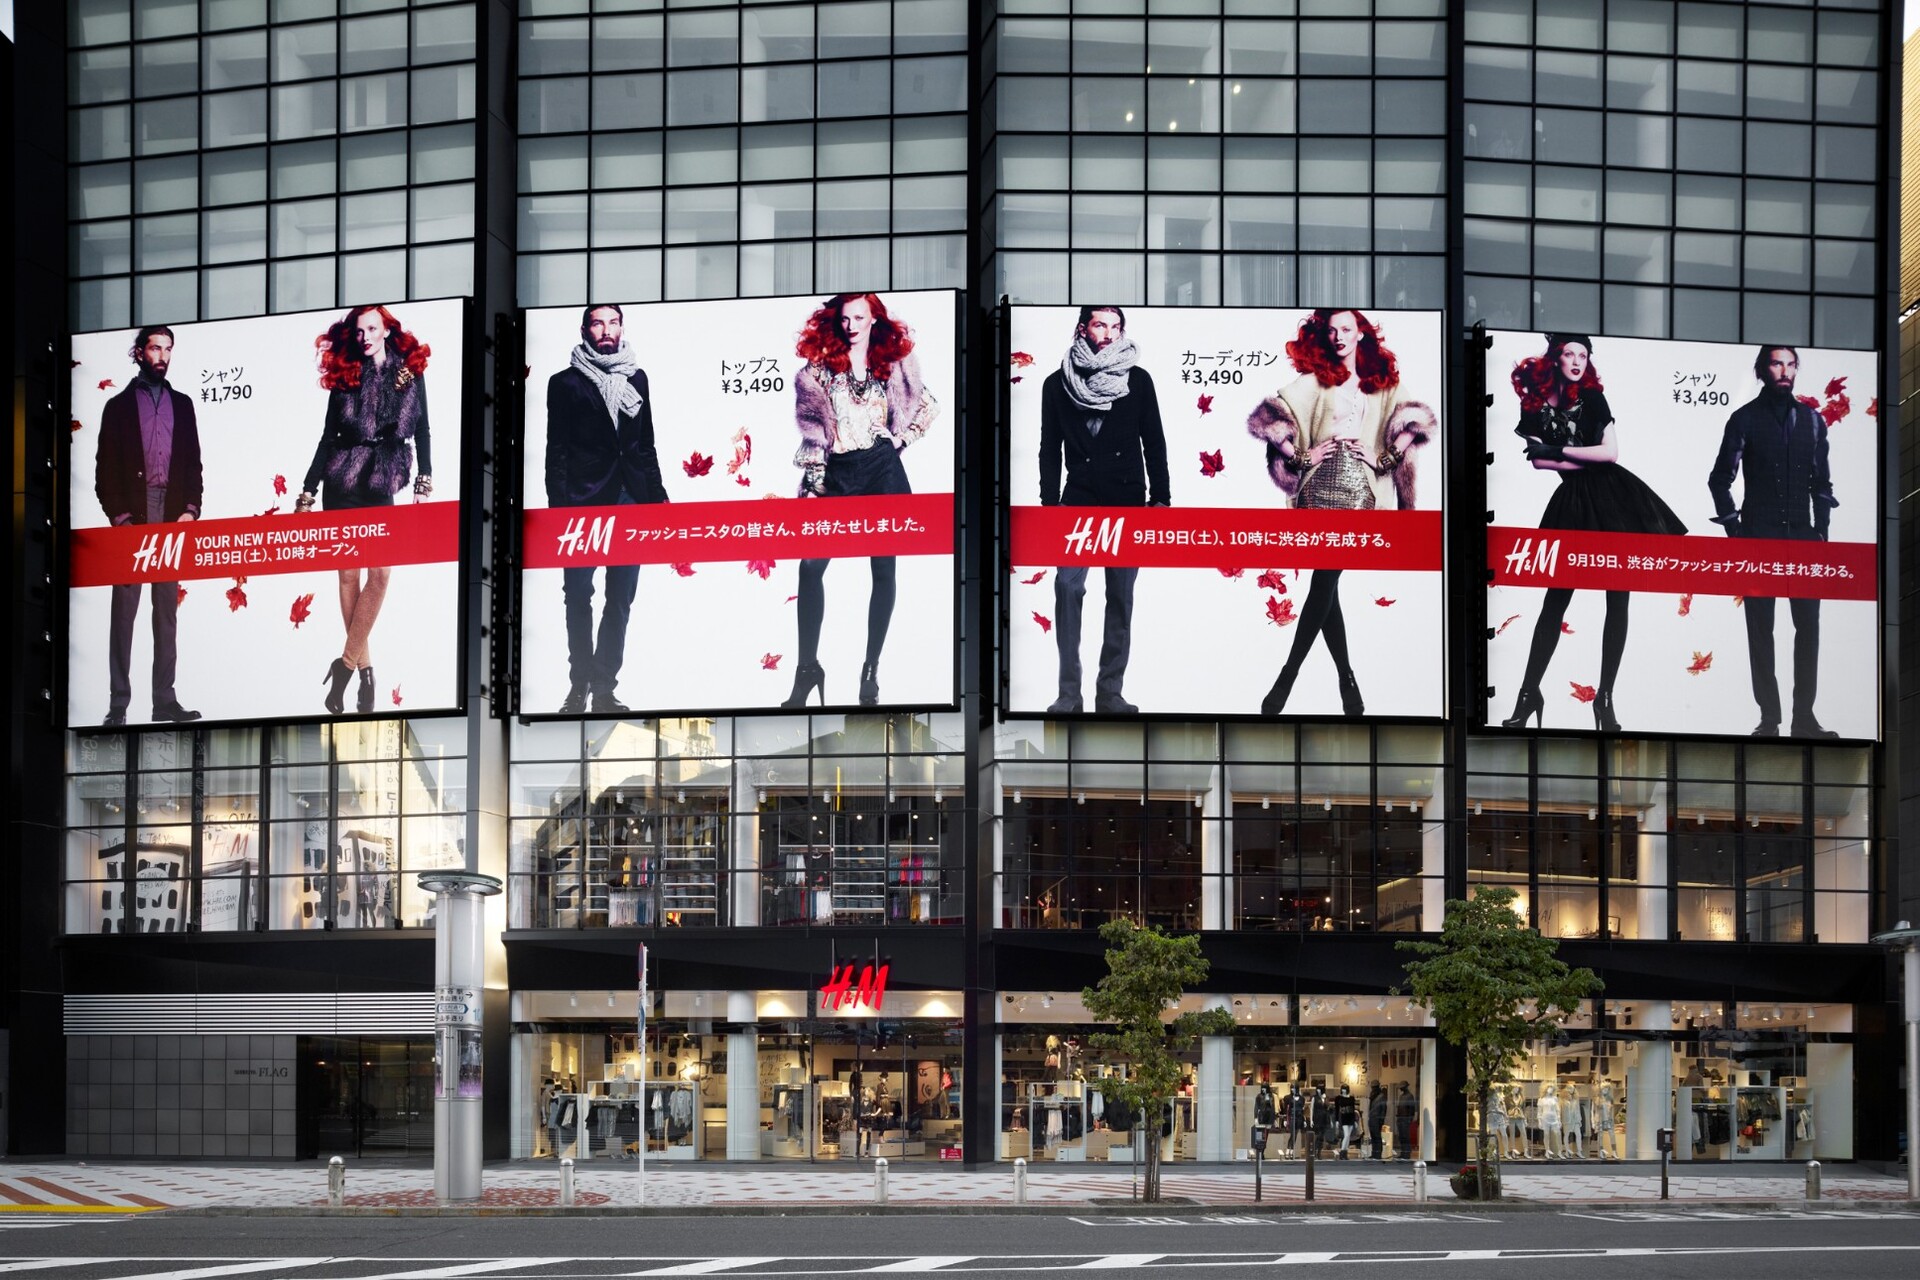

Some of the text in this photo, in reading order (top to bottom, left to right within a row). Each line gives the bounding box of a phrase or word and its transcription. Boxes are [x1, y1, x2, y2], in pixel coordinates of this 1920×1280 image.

[721, 357, 780, 375] トップス
[1182, 350, 1278, 367] カーディガン
[201, 366, 244, 383] シャツ
[1182, 369, 1243, 387] ¥3,490
[1673, 371, 1717, 387] シャツ
[201, 385, 252, 403] ¥1,790
[721, 377, 784, 396] ¥3,490
[1673, 389, 1730, 407] ¥3,490
[195, 523, 390, 549] YOUR NEW FAVOURITE STORE.
[557, 516, 615, 556] H&M
[625, 517, 926, 542] ファッショニスタの皆さん、お待たせしました。
[1065, 516, 1125, 557] H&M
[1133, 529, 1392, 549] 9月19日（土）、10時に渋谷が完成する。
[133, 531, 186, 573] H&M
[195, 544, 359, 566] 9月19日（土）、10時オープン。
[1505, 538, 1561, 578] H&M
[1567, 552, 1855, 579] 9月19日、渋谷がファッショナブルに生まれ変わる。
[820, 965, 889, 1011] H&M
